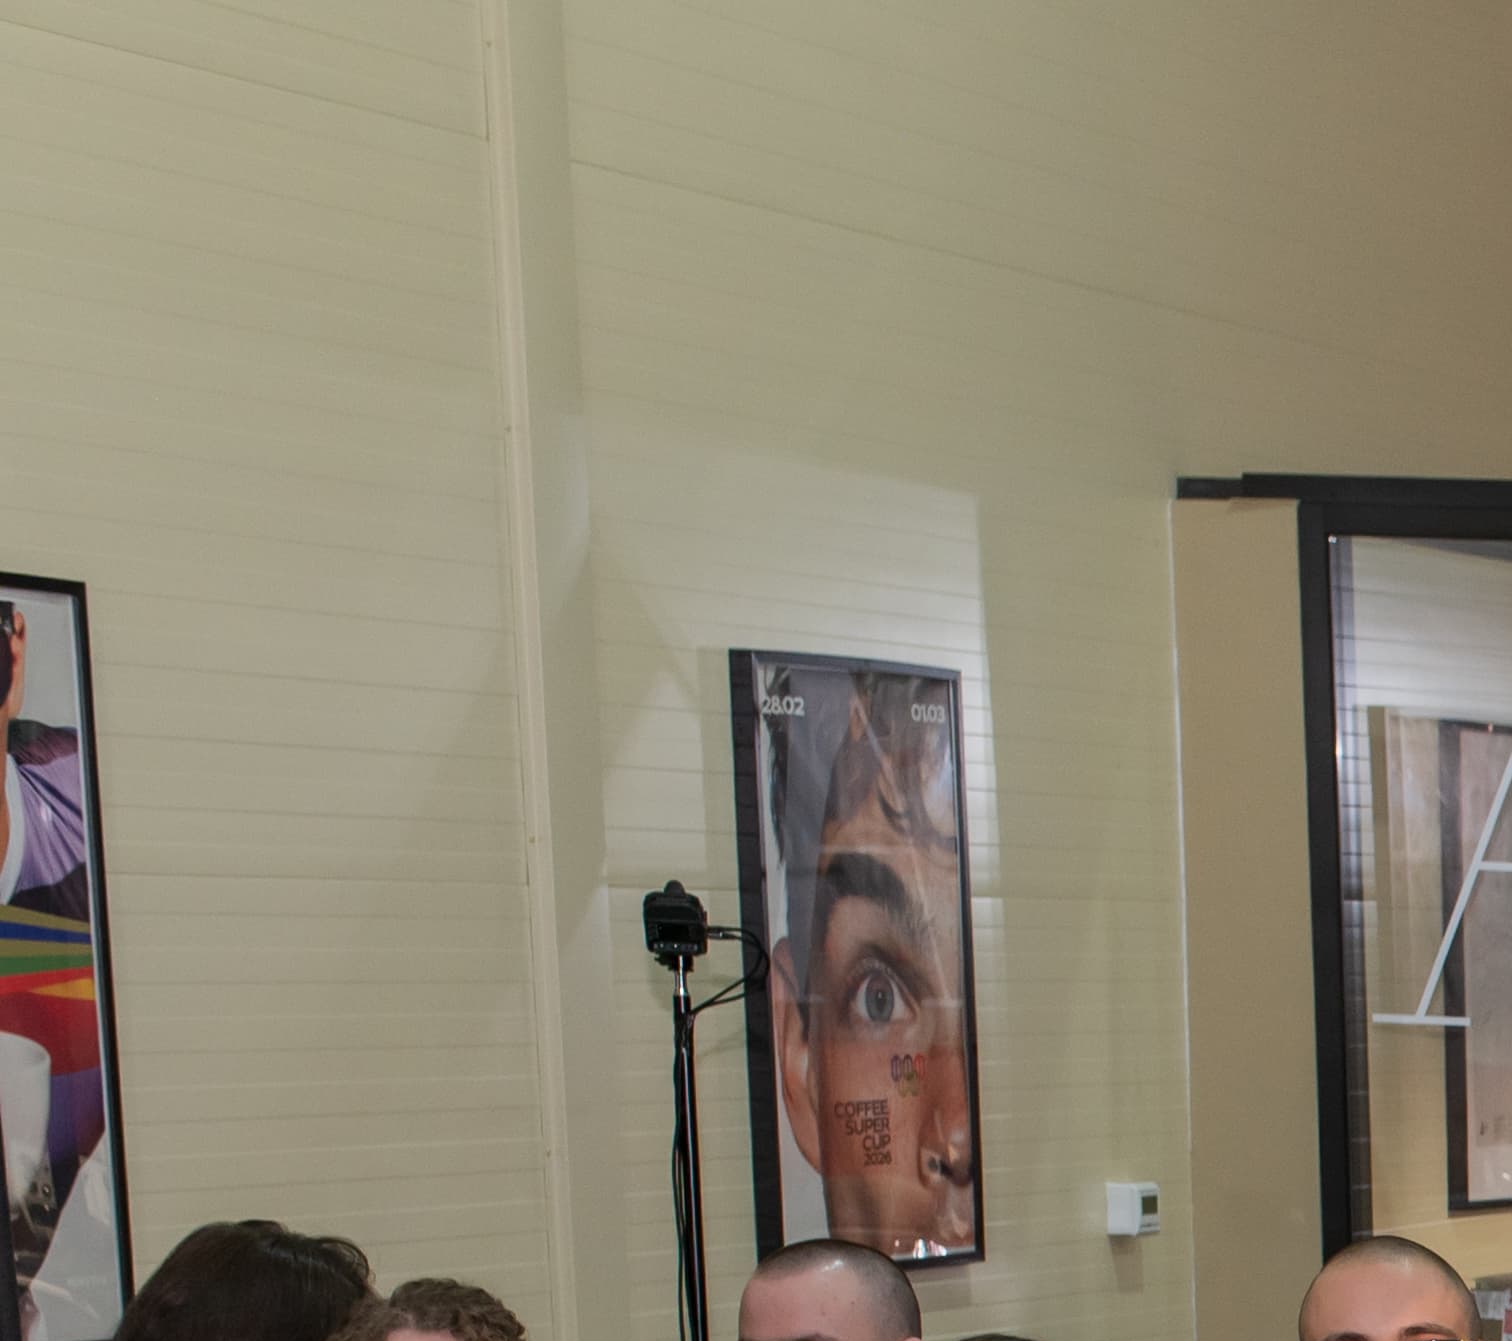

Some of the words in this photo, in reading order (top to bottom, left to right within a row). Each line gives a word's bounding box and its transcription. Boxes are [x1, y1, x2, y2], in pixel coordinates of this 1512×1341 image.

[762, 697, 806, 717] 28.02
[911, 703, 948, 724] 01.03
[833, 1099, 890, 1119] COFFEE
[845, 1117, 892, 1136] SUPER
[862, 1133, 892, 1152] CUP
[863, 1151, 893, 1167] 2026
